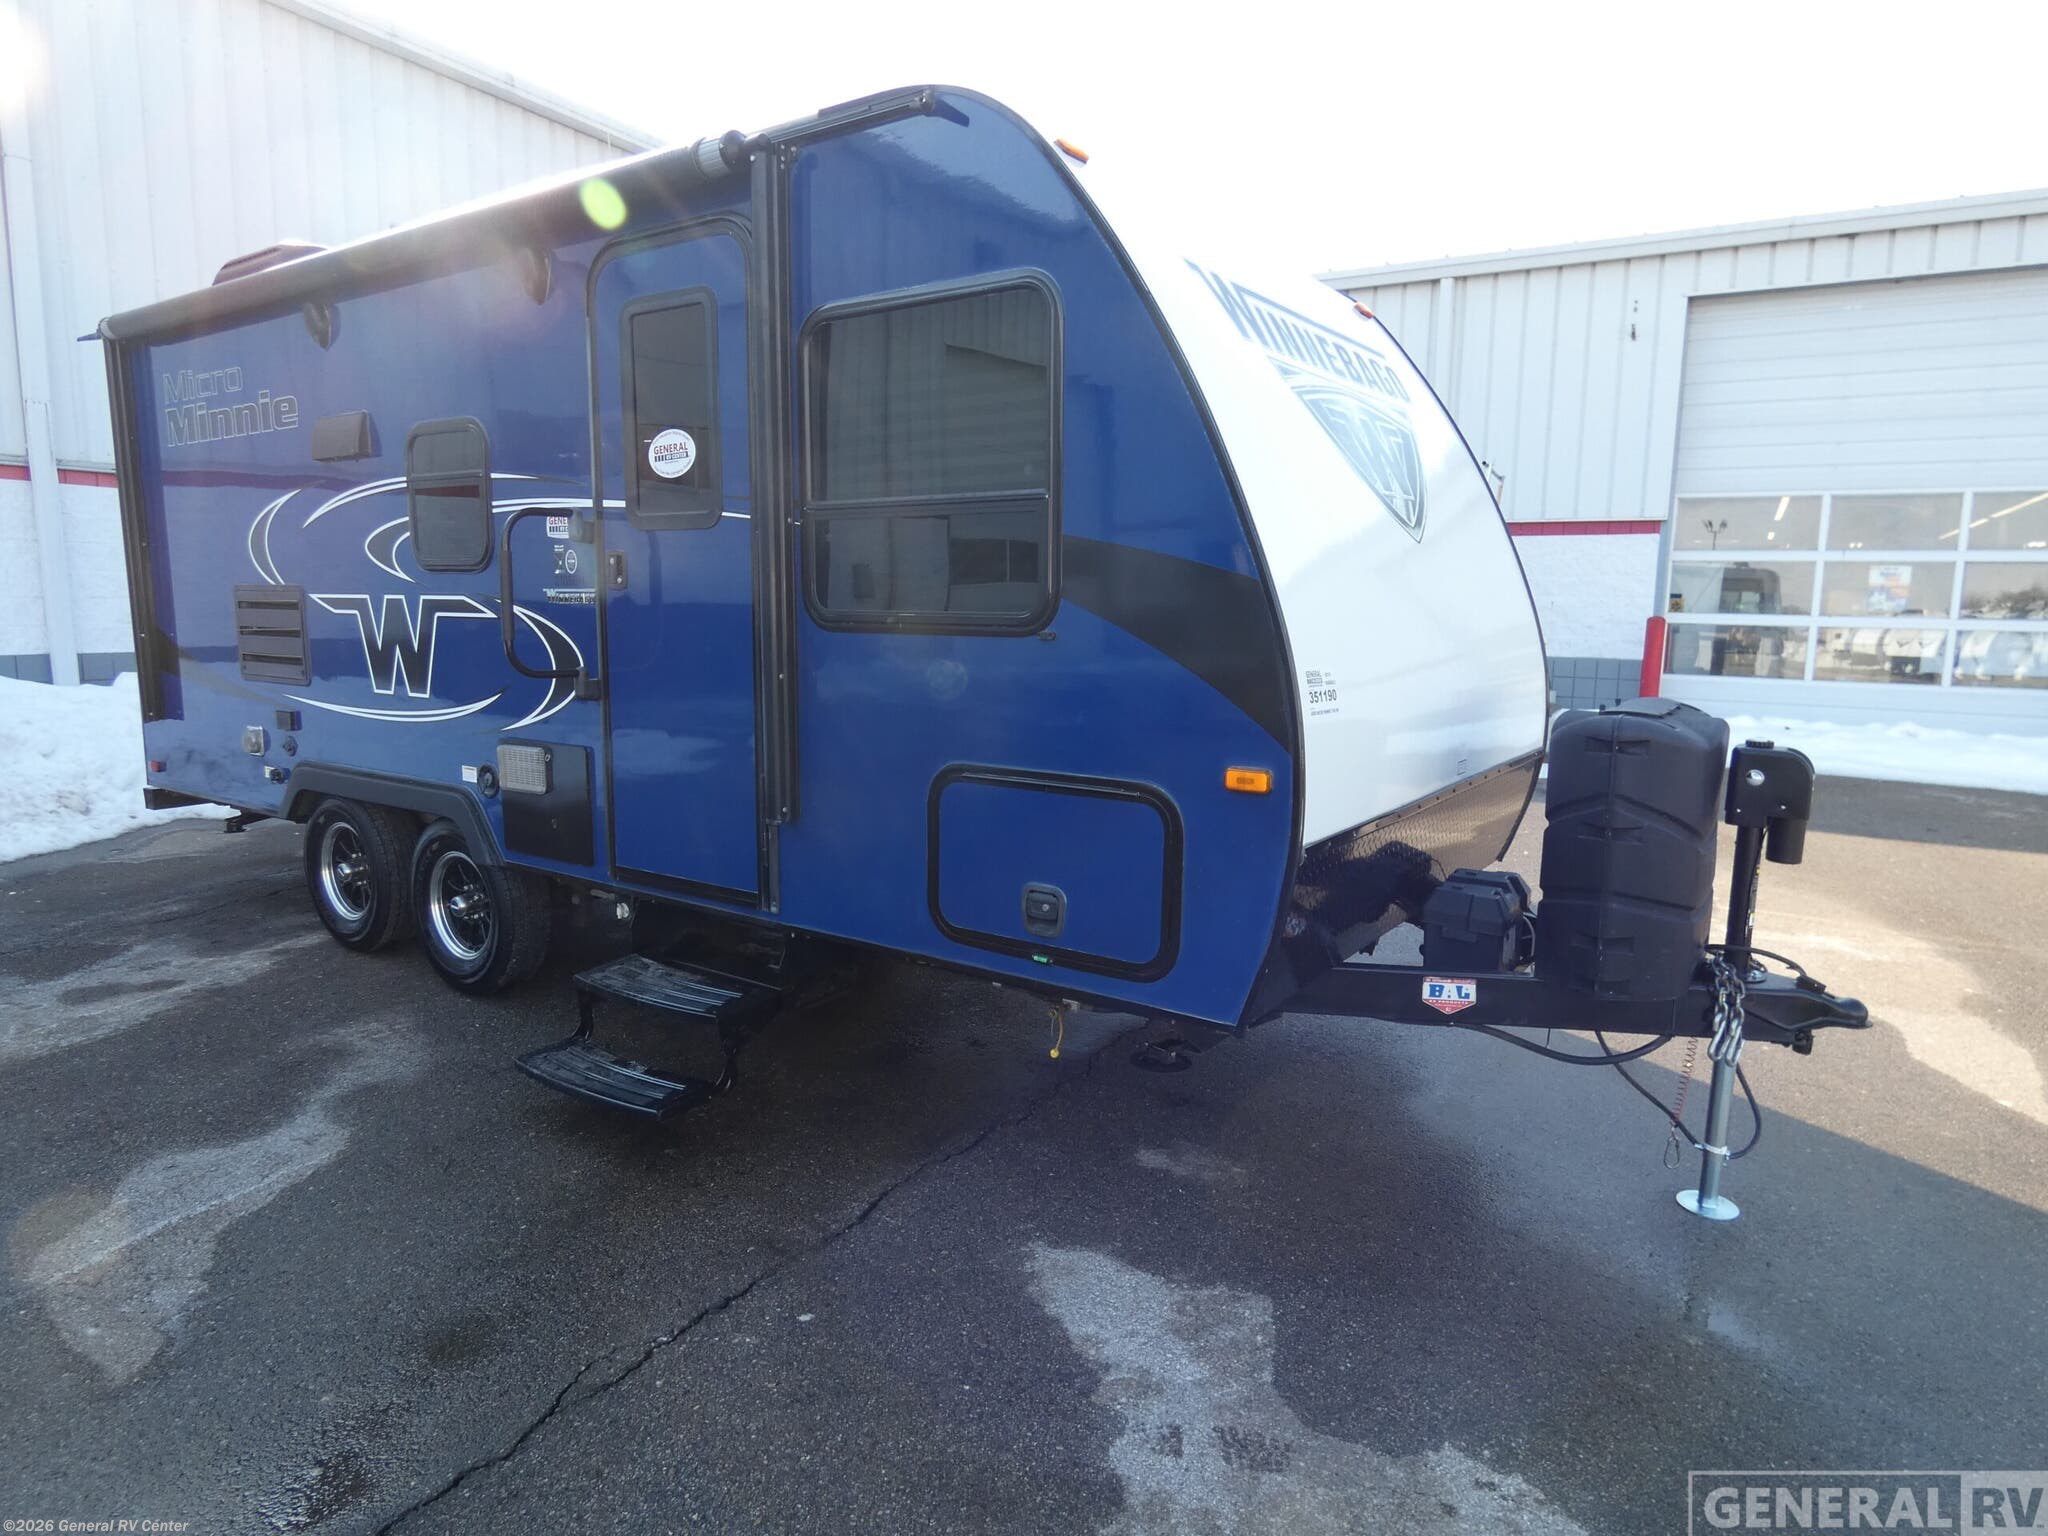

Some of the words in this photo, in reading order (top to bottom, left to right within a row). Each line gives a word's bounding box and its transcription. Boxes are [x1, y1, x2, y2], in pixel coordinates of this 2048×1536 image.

[1182, 257, 1411, 403] WINNEBAGO
[162, 366, 242, 404] Micro
[165, 390, 299, 447] Minnie
[654, 442, 688, 455] GENERAL
[549, 516, 568, 525] GENE
[1309, 688, 1337, 704] 351190
[1428, 983, 1470, 999] BAL
